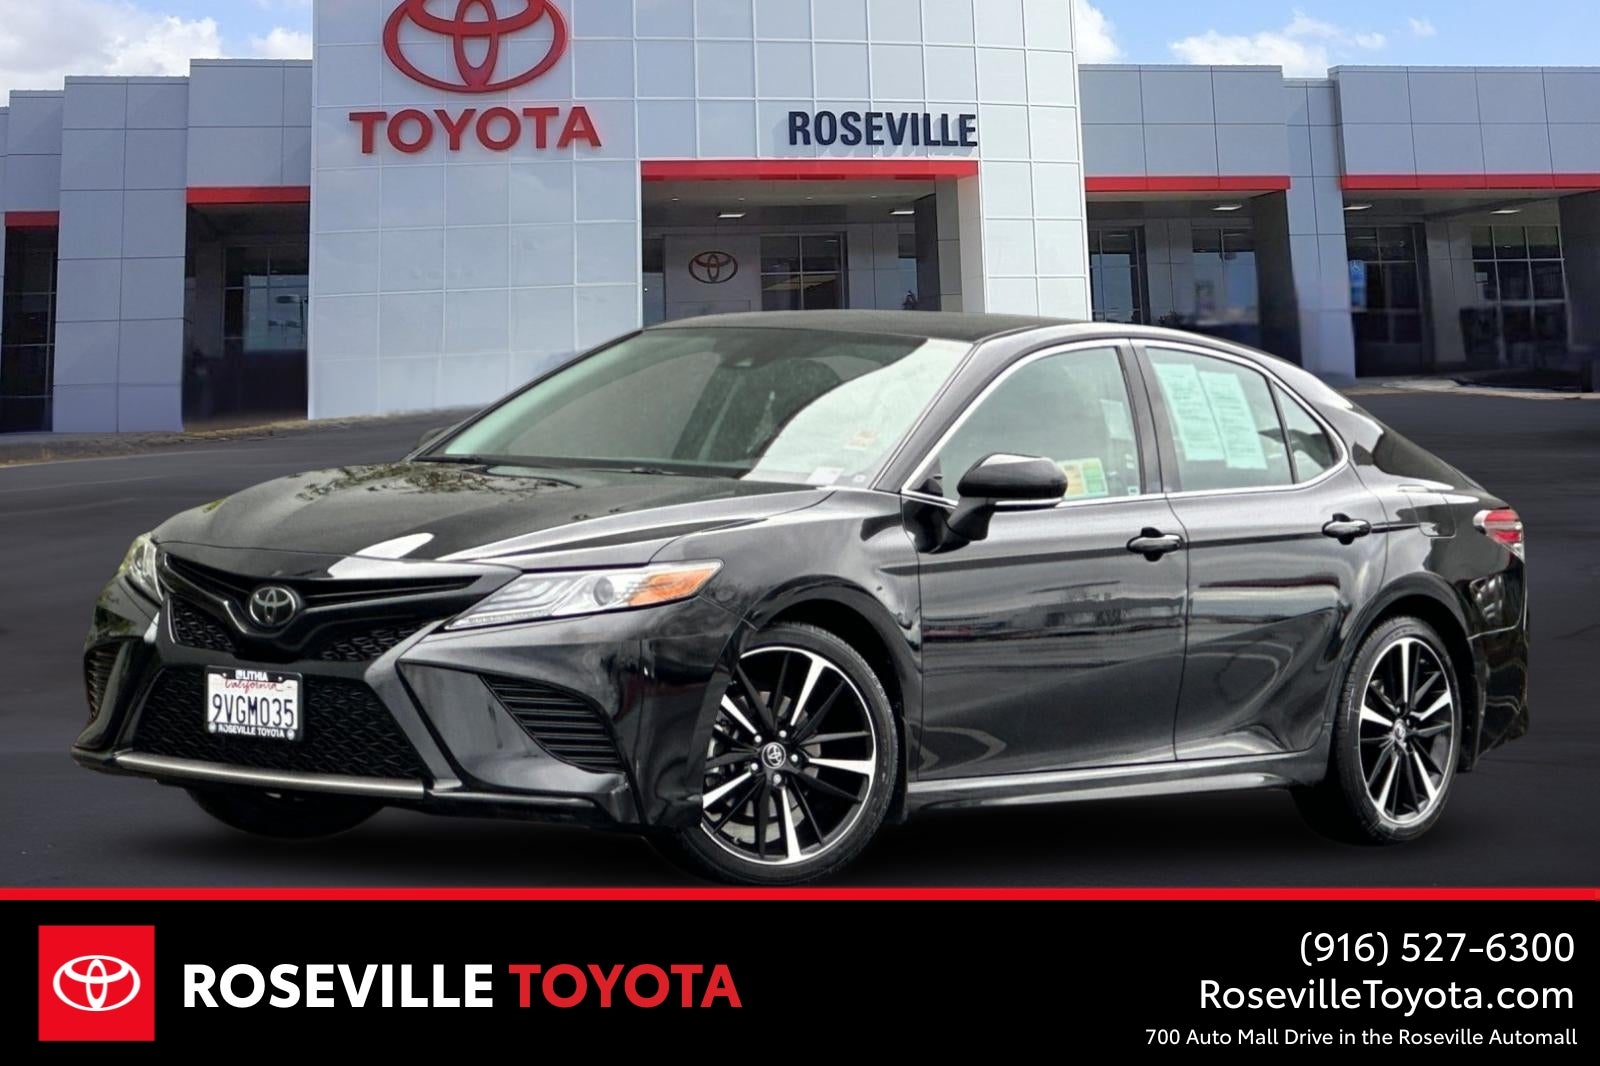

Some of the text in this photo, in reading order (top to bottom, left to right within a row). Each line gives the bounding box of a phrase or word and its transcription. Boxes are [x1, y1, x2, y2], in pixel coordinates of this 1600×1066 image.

[349, 105, 603, 154] TOYOTA
[788, 110, 978, 147] ROSEVILLE
[242, 670, 269, 681] LITHIA
[212, 693, 294, 728] 9VGM035
[218, 724, 285, 738] ROSEVILLE TOYOTA
